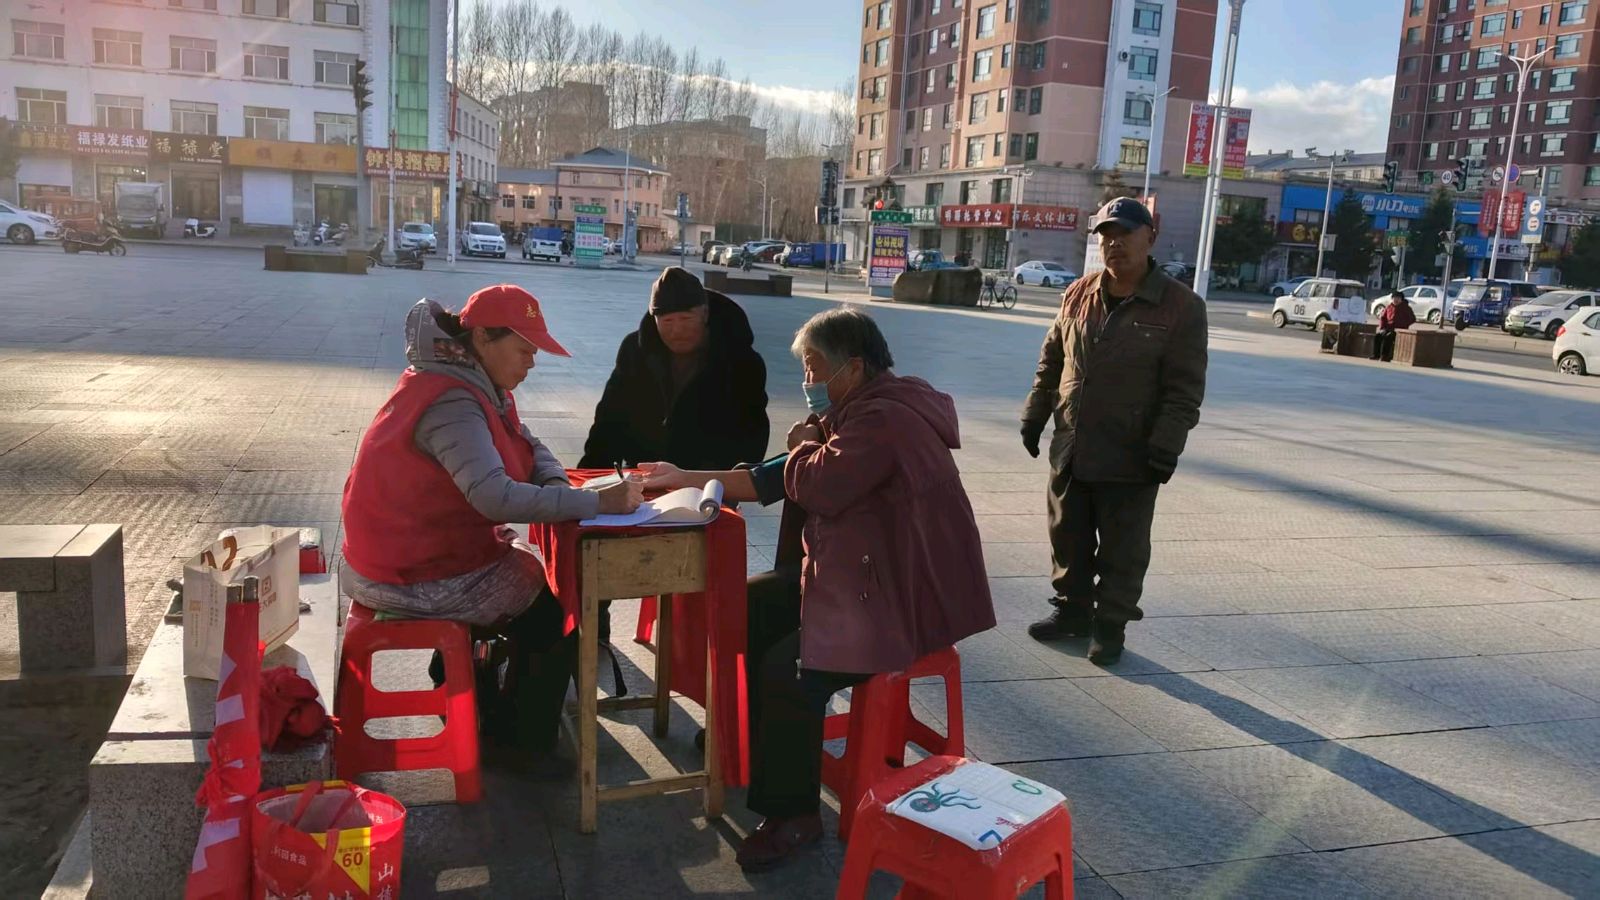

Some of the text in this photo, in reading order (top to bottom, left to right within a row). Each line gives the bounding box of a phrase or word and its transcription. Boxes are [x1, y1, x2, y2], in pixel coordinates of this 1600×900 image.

[77, 130, 149, 149] 福禄发纸业
[155, 137, 224, 158] 福禄堂
[1443, 173, 1450, 181] 40
[1294, 304, 1305, 315] 06
[342, 852, 364, 868] 60
